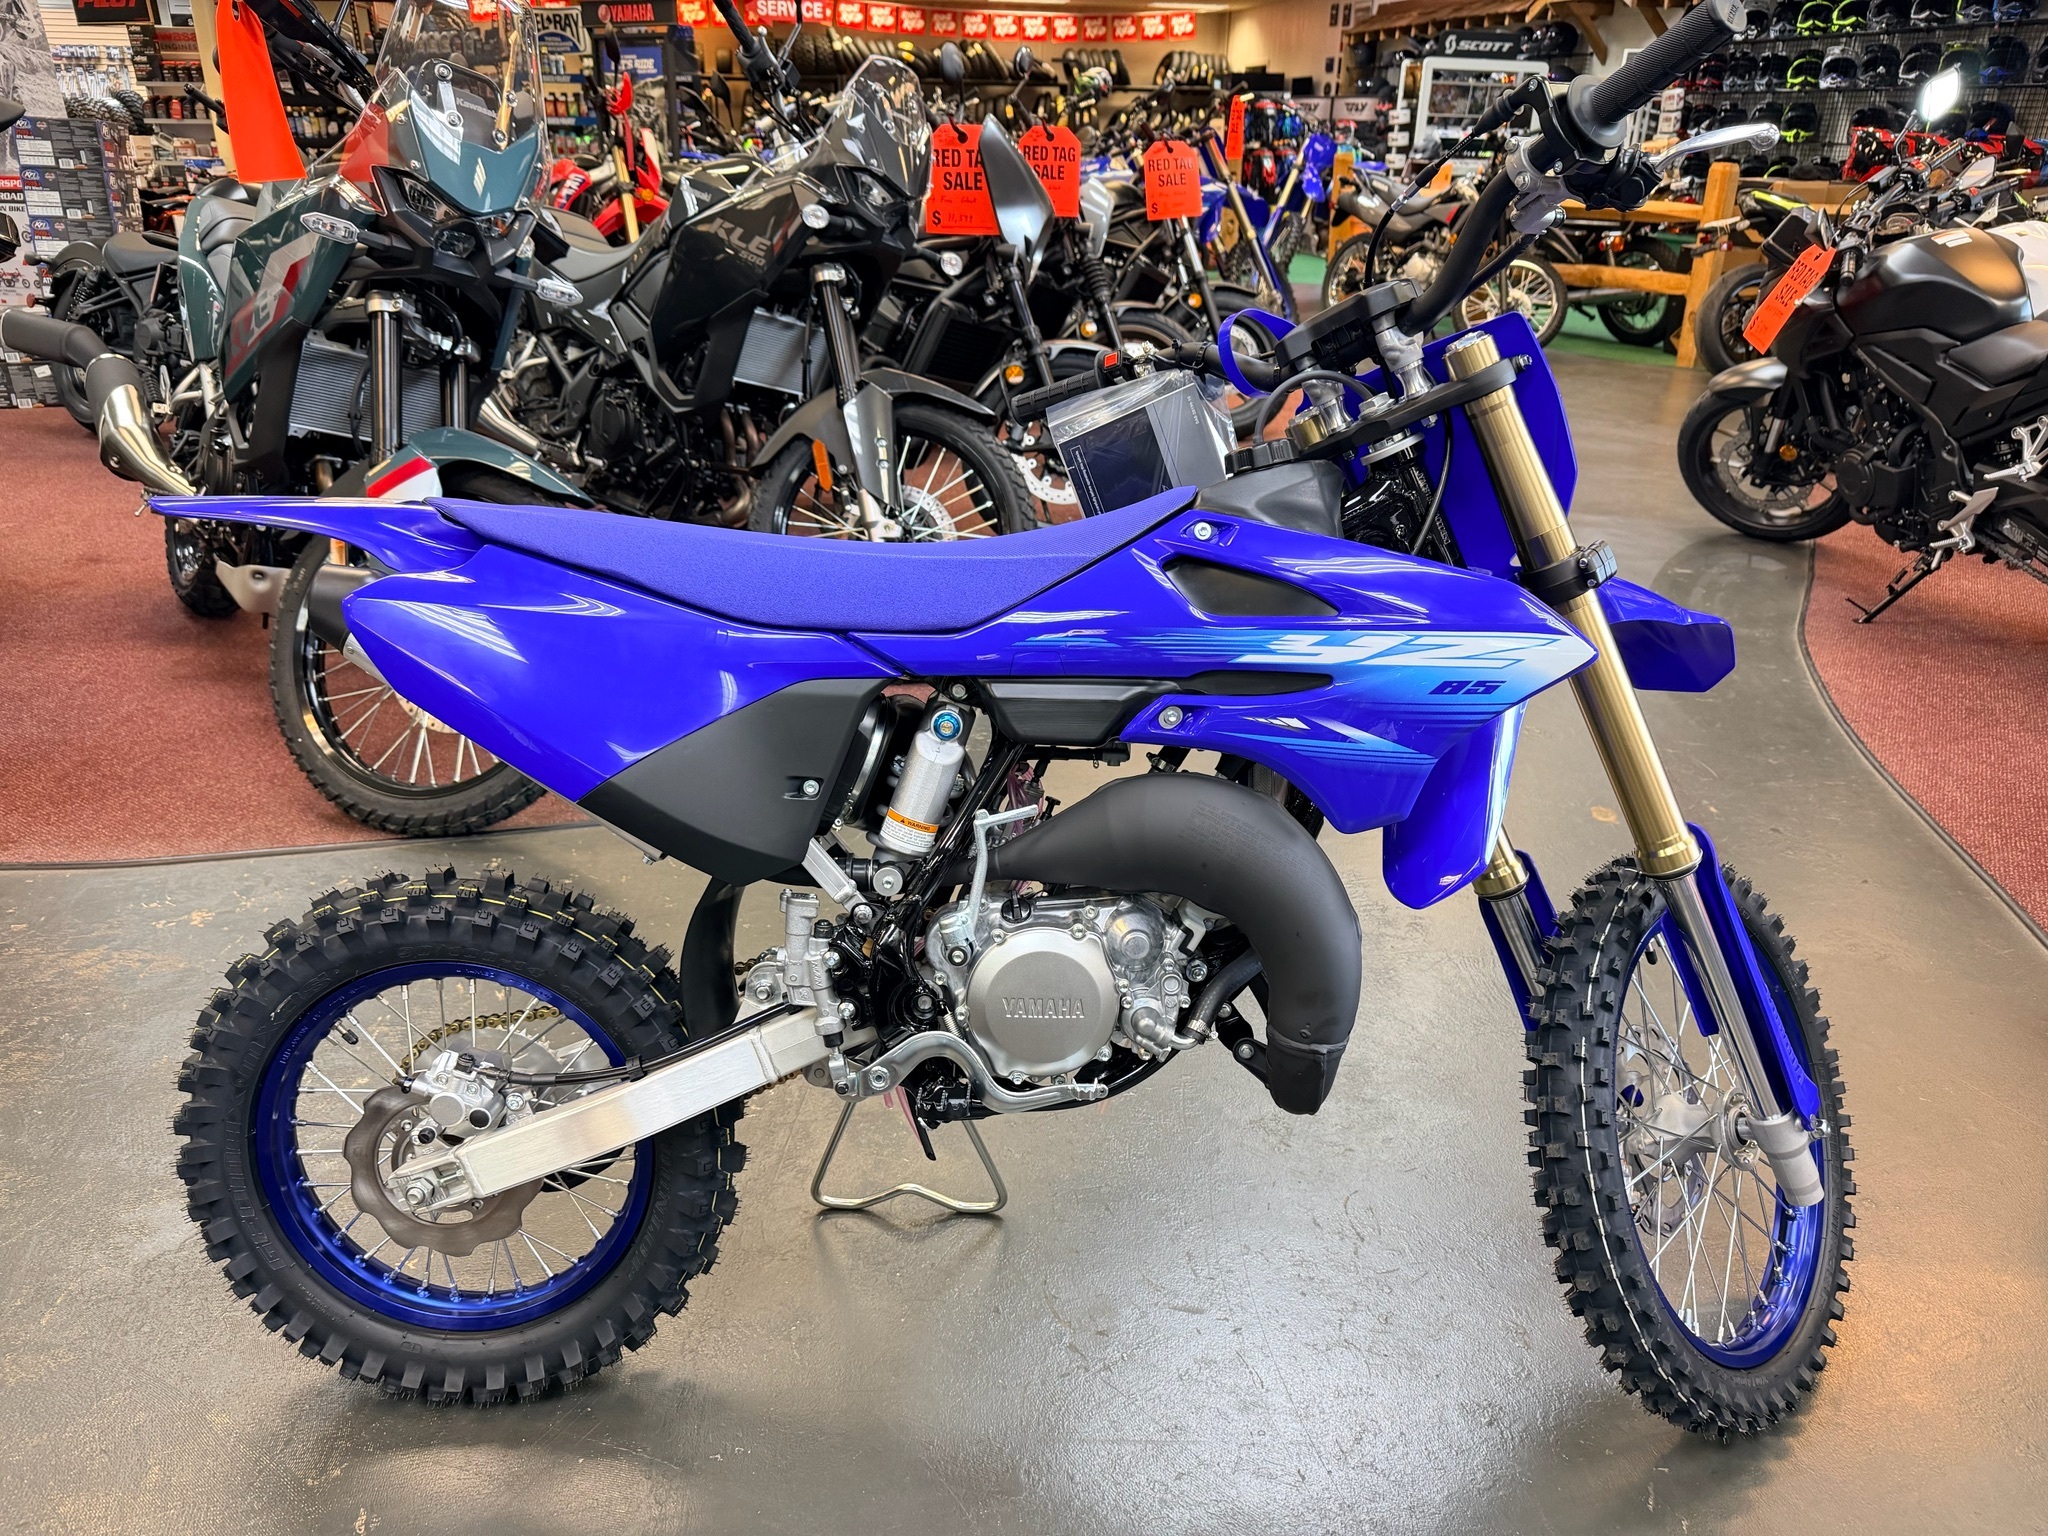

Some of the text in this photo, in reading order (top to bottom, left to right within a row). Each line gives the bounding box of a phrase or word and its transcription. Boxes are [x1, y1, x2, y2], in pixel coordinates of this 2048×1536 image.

[610, 5, 654, 22] YAMAHA
[757, 0, 823, 19] SERVCE
[1456, 41, 1513, 53] SCOTT
[456, 97, 500, 118] Kawasak
[1023, 145, 1076, 162] RED TAG
[1034, 164, 1065, 180] SALE
[1148, 158, 1194, 172] RED TAG
[943, 171, 983, 190] SALE
[1158, 173, 1187, 187] SALE
[1151, 203, 1158, 214] $
[932, 211, 941, 226] $
[708, 217, 772, 257] KLE
[738, 252, 766, 266] 500
[1228, 634, 1560, 668] YZ
[1428, 680, 1507, 695] 85
[907, 821, 931, 831] WARNING
[1002, 996, 1085, 1019] YAMAHA
